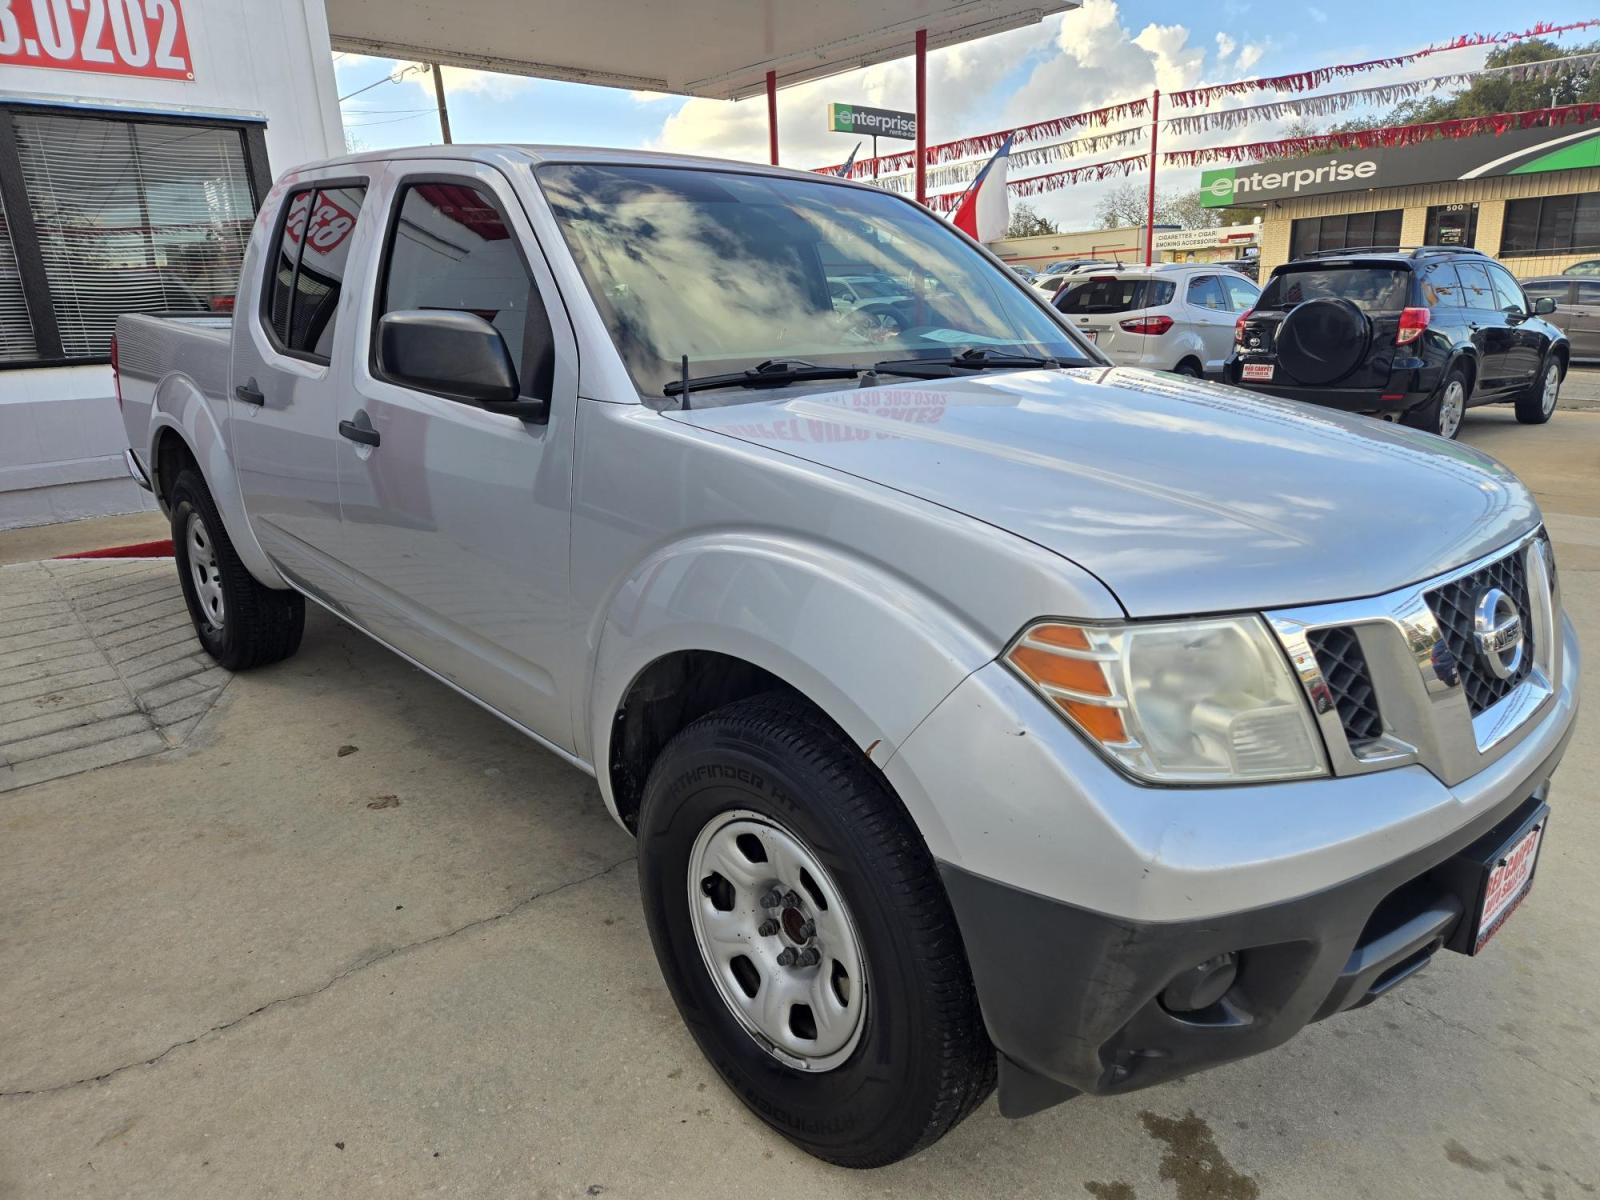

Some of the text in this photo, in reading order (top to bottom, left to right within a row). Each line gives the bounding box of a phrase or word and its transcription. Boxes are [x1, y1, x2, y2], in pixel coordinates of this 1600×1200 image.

[839, 111, 916, 131] enterprise
[888, 130, 916, 138] rent-a-ca
[1208, 160, 1377, 197] enterprise
[1446, 204, 1464, 212] 500
[1158, 232, 1193, 241] CIGARETTES
[1155, 240, 1181, 248] SMOKING
